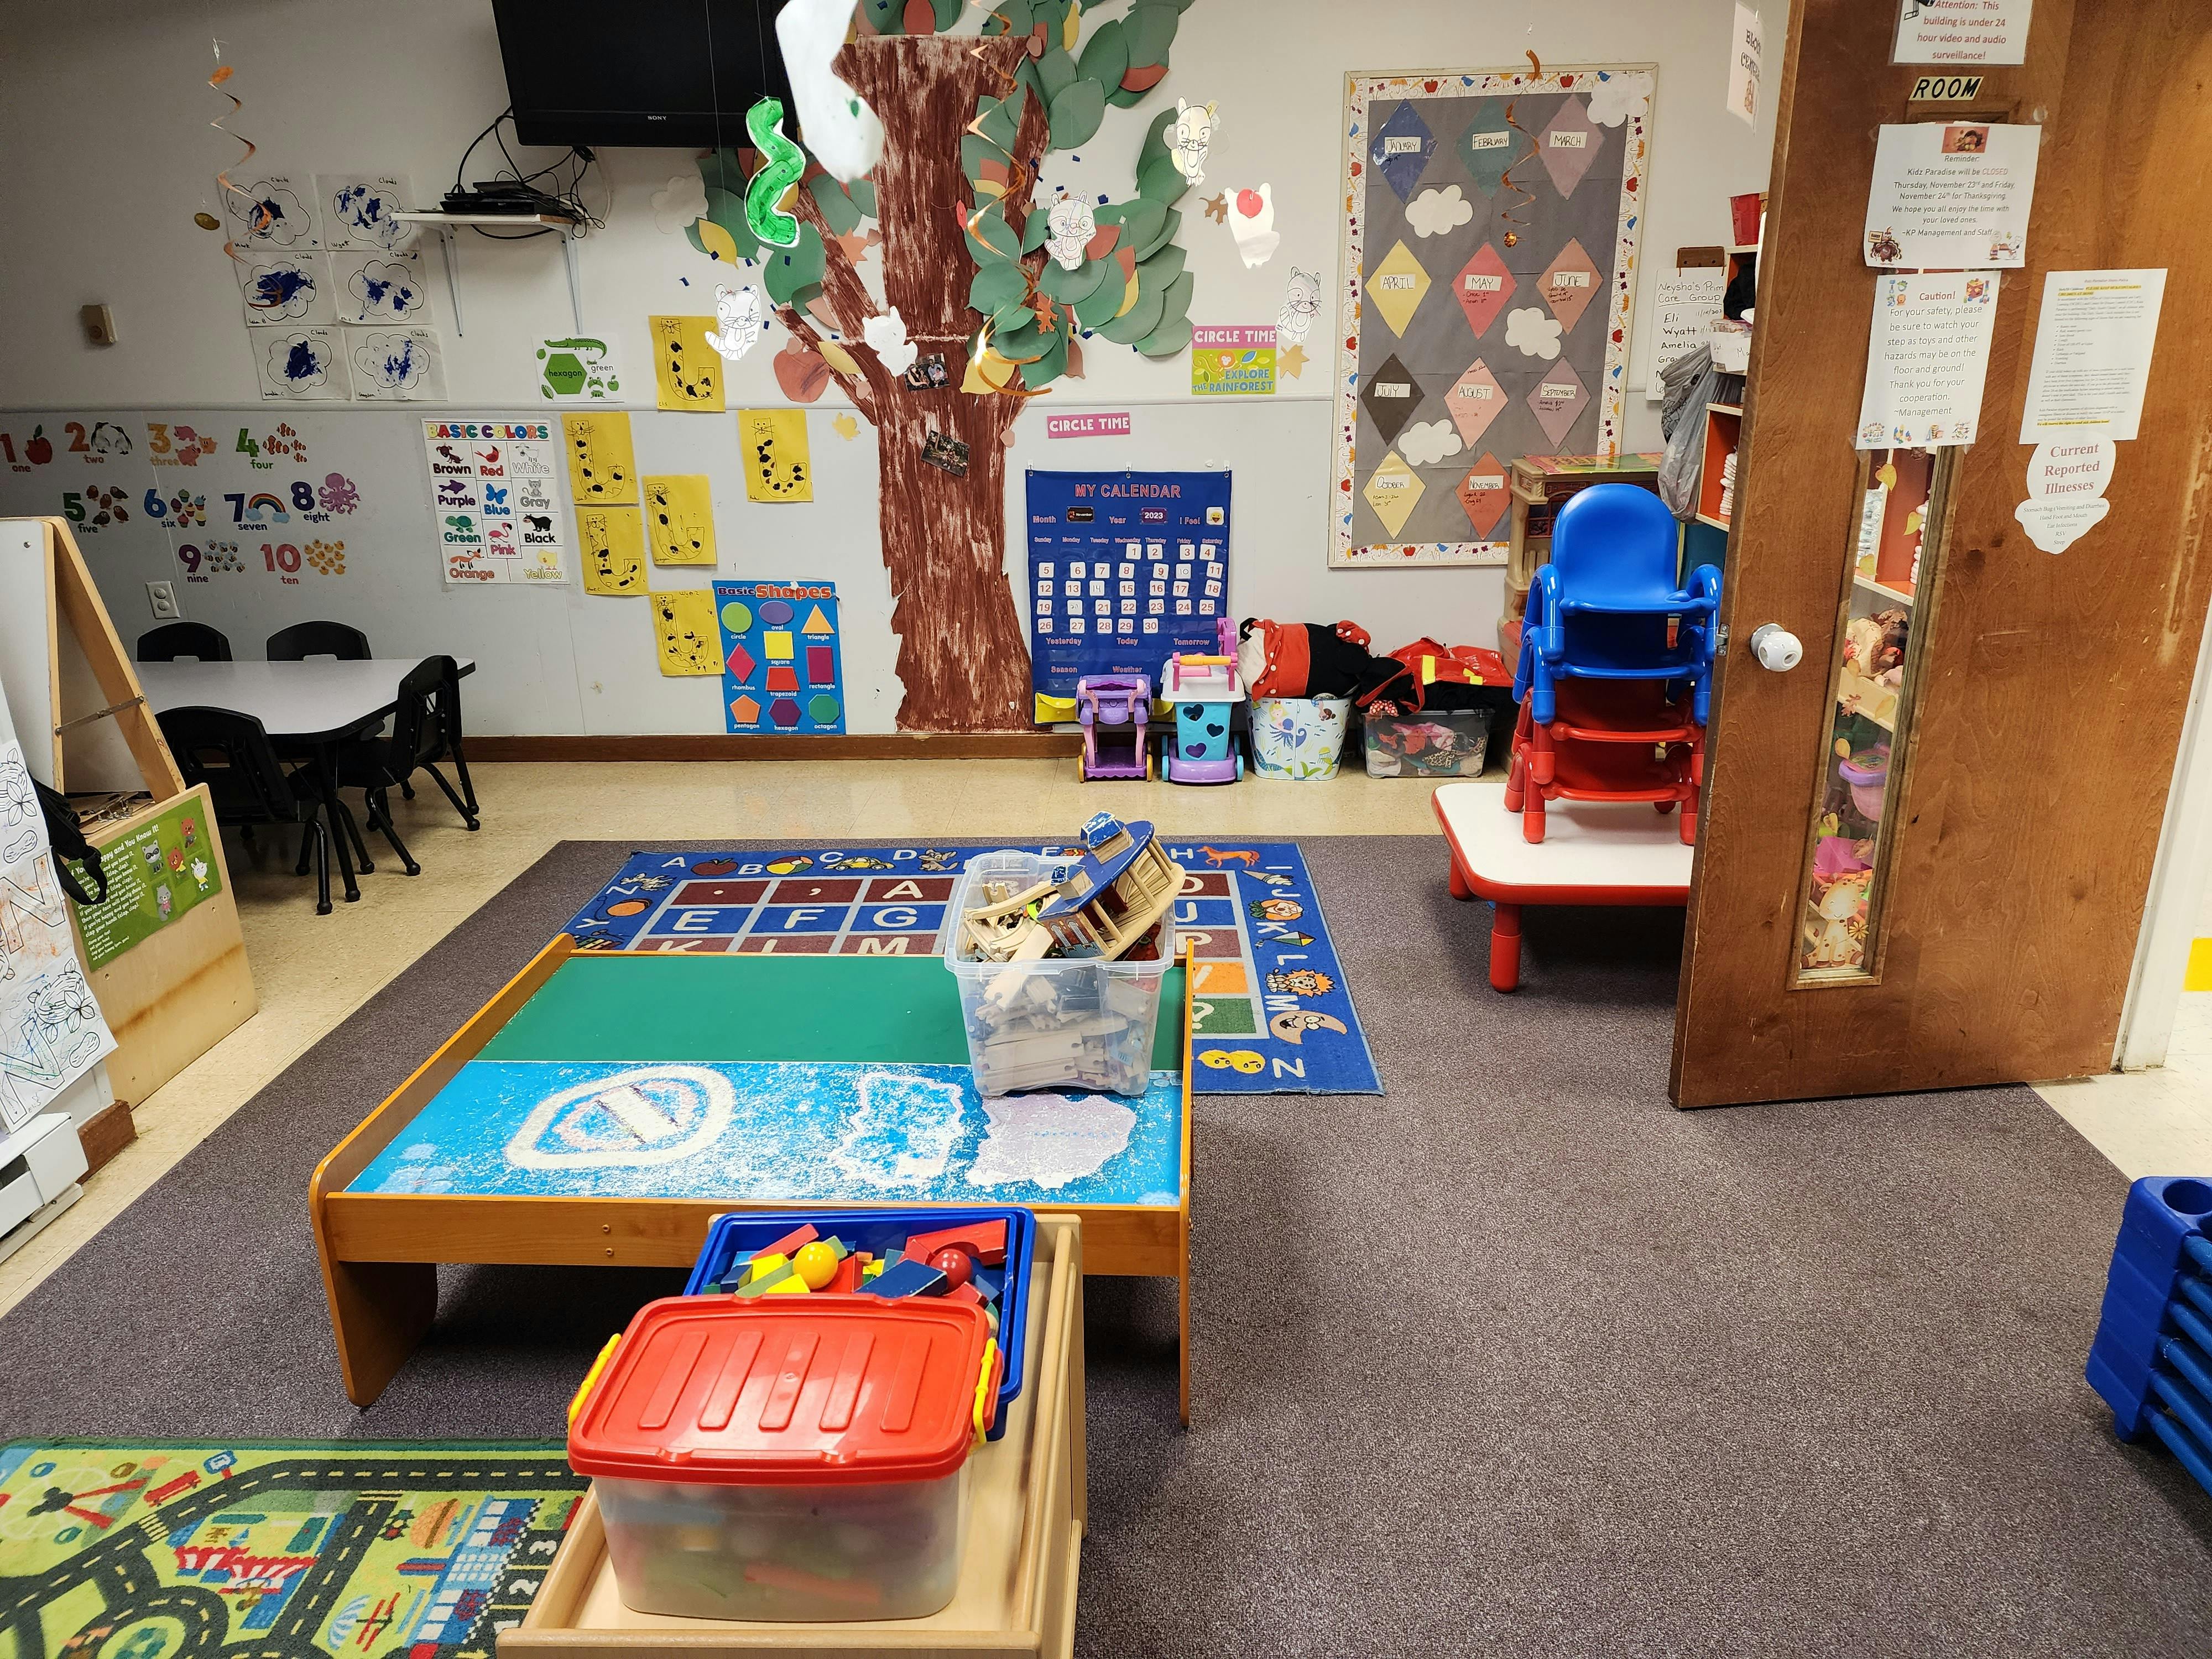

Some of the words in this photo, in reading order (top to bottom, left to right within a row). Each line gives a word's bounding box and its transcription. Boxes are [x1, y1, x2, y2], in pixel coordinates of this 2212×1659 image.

[1936, 1, 1978, 9] Attention:
[1983, 1, 1999, 10] This
[1923, 17, 1957, 27] building
[1917, 34, 1937, 42] hour
[1964, 35, 1980, 43] and
[1983, 35, 2006, 44] audio
[1932, 51, 1986, 60] surveillance!
[1913, 78, 1981, 98] ROOM
[1386, 139, 1417, 152] JANUARY
[1473, 135, 1508, 147] FEBRUARY
[1553, 135, 1581, 147] MARCH
[1383, 277, 1413, 289] APRIL
[1472, 278, 1494, 289] MAY
[1554, 274, 1582, 287] JUNE
[1658, 282, 1700, 294] Neysha's
[1658, 294, 1680, 302] Care
[1689, 294, 1720, 304] Group
[1919, 291, 1955, 301] Caution!
[1906, 307, 1924, 317] your
[1927, 306, 1953, 316] safety,
[1955, 305, 1982, 315] please
[1664, 313, 1679, 323] Eli
[1890, 323, 1900, 331] be
[1934, 320, 1958, 330] watch
[1960, 320, 1979, 330] your
[1194, 331, 1239, 342] CIRCLE
[1245, 331, 1276, 342] TIME
[1663, 326, 1697, 338] Wyatt
[1661, 341, 1697, 349] Amelia
[1887, 338, 1905, 347] step
[1919, 336, 1936, 345] toys
[1938, 335, 1953, 343] and
[1955, 334, 1978, 342] other
[1884, 351, 1916, 360] hazards
[1919, 351, 1936, 359] may
[1938, 349, 1948, 358] be
[549, 369, 582, 378] hexagon
[591, 364, 613, 373] green
[1225, 369, 1269, 379] EXPLORE
[1893, 366, 1913, 374] floor
[1915, 364, 1930, 373] and
[1933, 363, 1964, 374] ground!
[1193, 383, 1207, 392] THE
[1209, 381, 1273, 392] RAINFOREST
[1889, 380, 1914, 389] Thank
[1916, 380, 1931, 389] you
[1933, 379, 1945, 387] for
[1947, 378, 1964, 388] your
[1459, 388, 1490, 399] AUGUST
[1543, 386, 1575, 397] SEPTEMBER
[1900, 394, 1950, 404] cooperation.
[1893, 407, 1952, 417] ~Management
[1050, 419, 1093, 431] CIRCLE
[1099, 418, 1129, 430] TIME
[64, 422, 90, 452] 2
[427, 424, 478, 438] BASIC
[482, 425, 548, 439] COLORS
[147, 424, 170, 453] 3
[235, 428, 259, 457] 4
[0, 434, 16, 463] 1
[2051, 444, 2100, 457] Current
[83, 454, 104, 463] two
[150, 456, 180, 466] three
[251, 459, 274, 469] four
[12, 464, 31, 473] one
[433, 463, 471, 474] Brown
[480, 465, 503, 476] Red
[512, 462, 549, 474] White
[2044, 461, 2100, 477] Reported
[1376, 476, 1405, 488] OCTOBER
[1469, 479, 1499, 490] NOVEMBER
[1075, 484, 1096, 497] MY
[1101, 484, 1181, 498] CALENDAR
[2044, 482, 2094, 494] Illnesses
[290, 482, 315, 511] 8
[438, 495, 476, 508] Purple
[63, 492, 86, 521] 5
[144, 489, 167, 518] 6
[224, 493, 246, 522] 7
[520, 497, 550, 509] Gray
[484, 504, 510, 515] Blue
[303, 512, 330, 523] eight
[1033, 515, 1056, 524] Month
[1109, 516, 1126, 524] Year
[78, 523, 98, 534] five
[162, 519, 175, 528] six
[238, 522, 267, 531] seven
[444, 532, 481, 543] Green
[524, 533, 556, 543] Black
[491, 544, 516, 555] Pink
[178, 544, 201, 573] 9
[260, 544, 301, 572] 10
[187, 573, 208, 583] nine
[450, 568, 494, 581] Orange
[524, 568, 562, 579] Yellow
[280, 576, 299, 585] ten
[718, 587, 754, 595] Basic
[755, 585, 831, 601] Shapes
[1046, 638, 1082, 646] Yesterday
[1117, 638, 1138, 646] Today
[114, 843, 125, 854] and
[125, 839, 135, 848] You
[136, 831, 152, 842] Know
[883, 880, 924, 899] A
[672, 911, 719, 931] E
[784, 909, 825, 930] F
[873, 907, 918, 927] G
